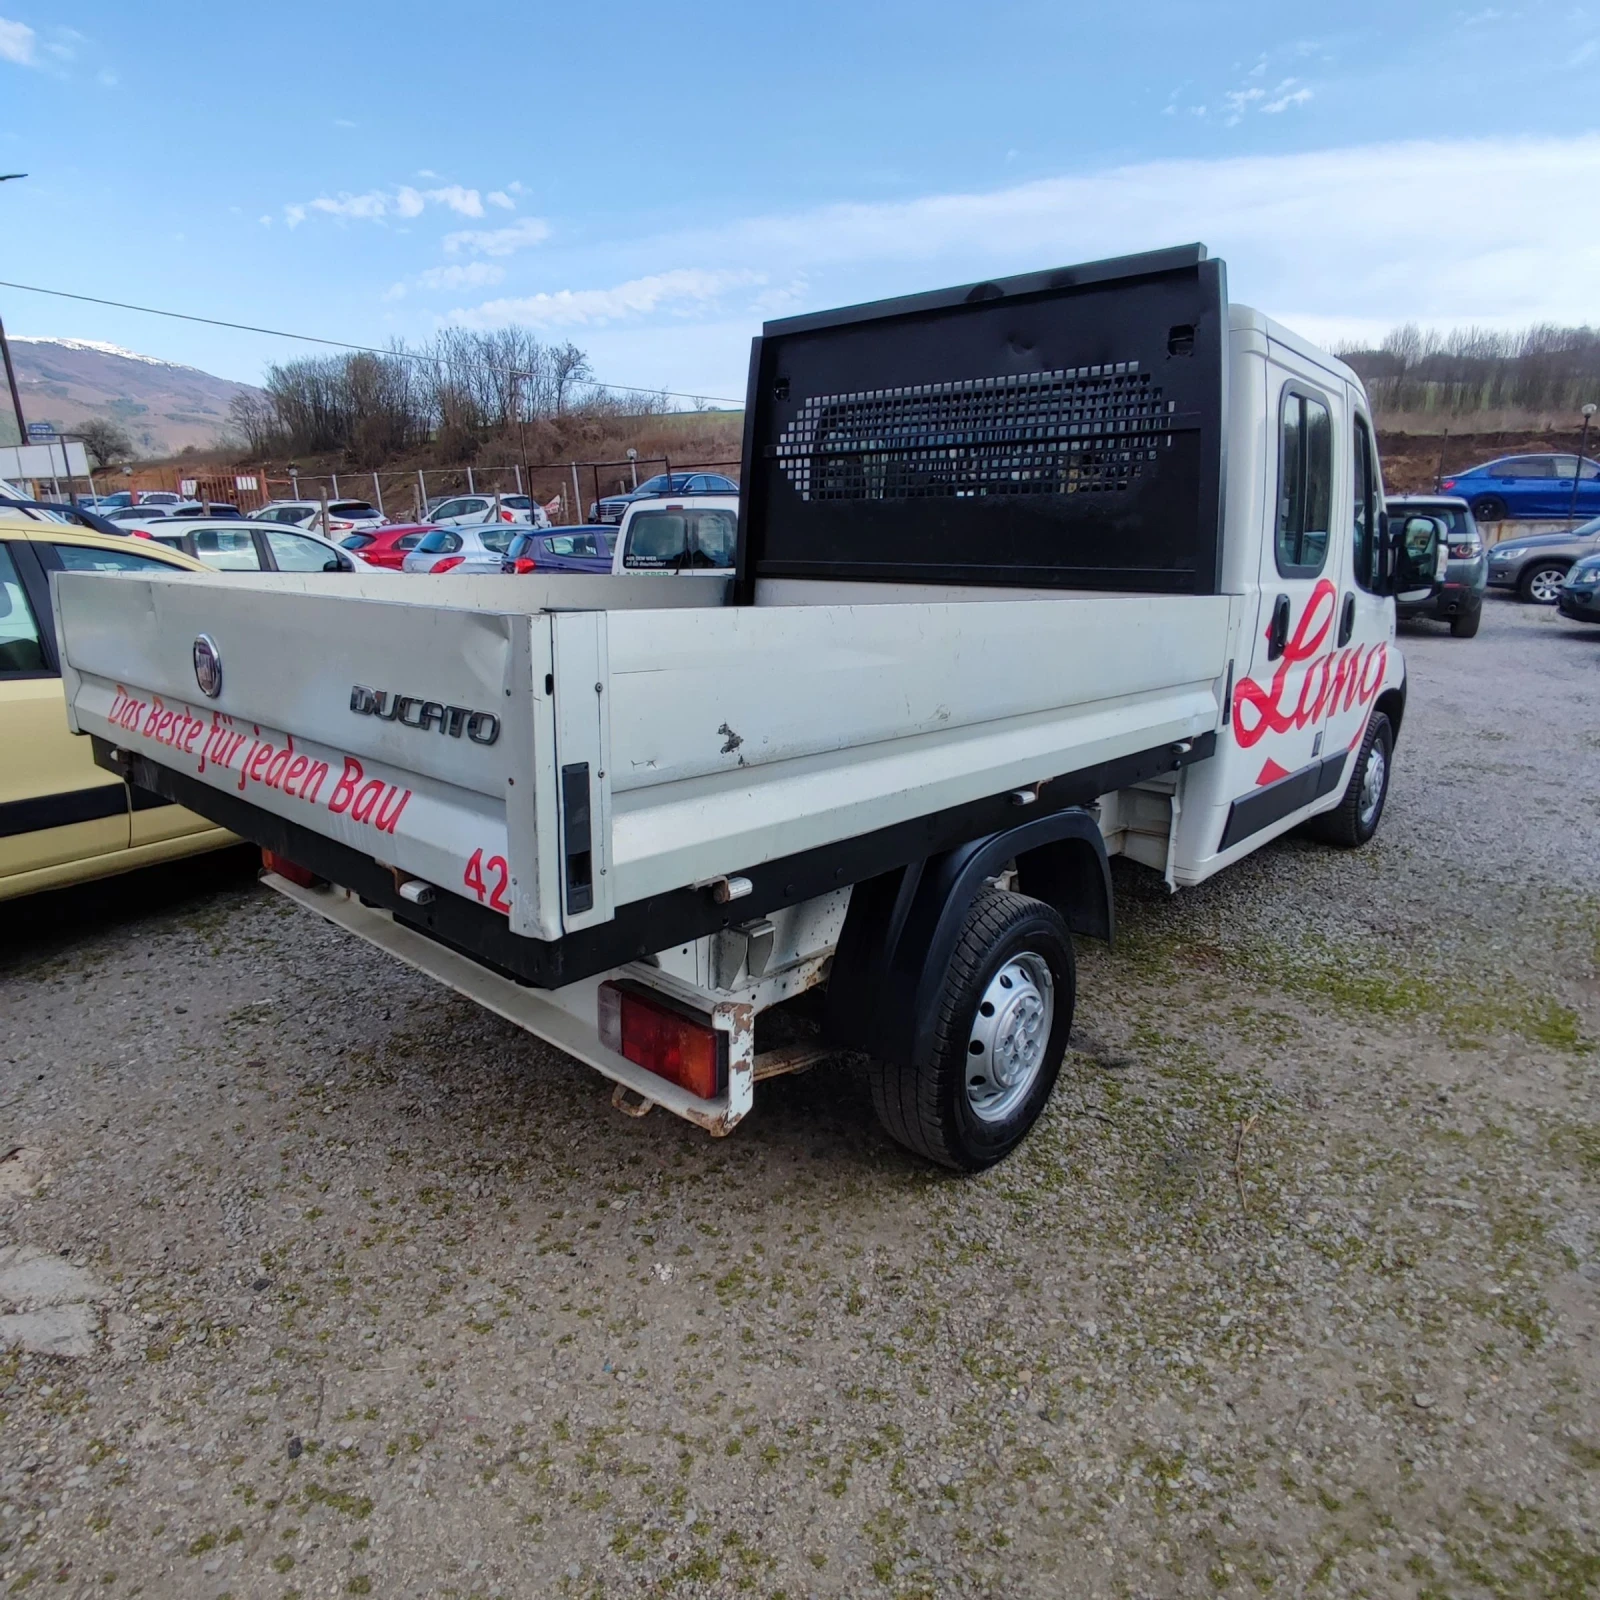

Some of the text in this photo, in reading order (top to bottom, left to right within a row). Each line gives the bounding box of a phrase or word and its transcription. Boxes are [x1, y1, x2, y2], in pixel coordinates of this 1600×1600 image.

[350, 684, 501, 746] DUCATO
[1232, 578, 1387, 753] Lang
[108, 684, 411, 834] Das Beste für jeden Bau
[463, 847, 510, 917] 42
